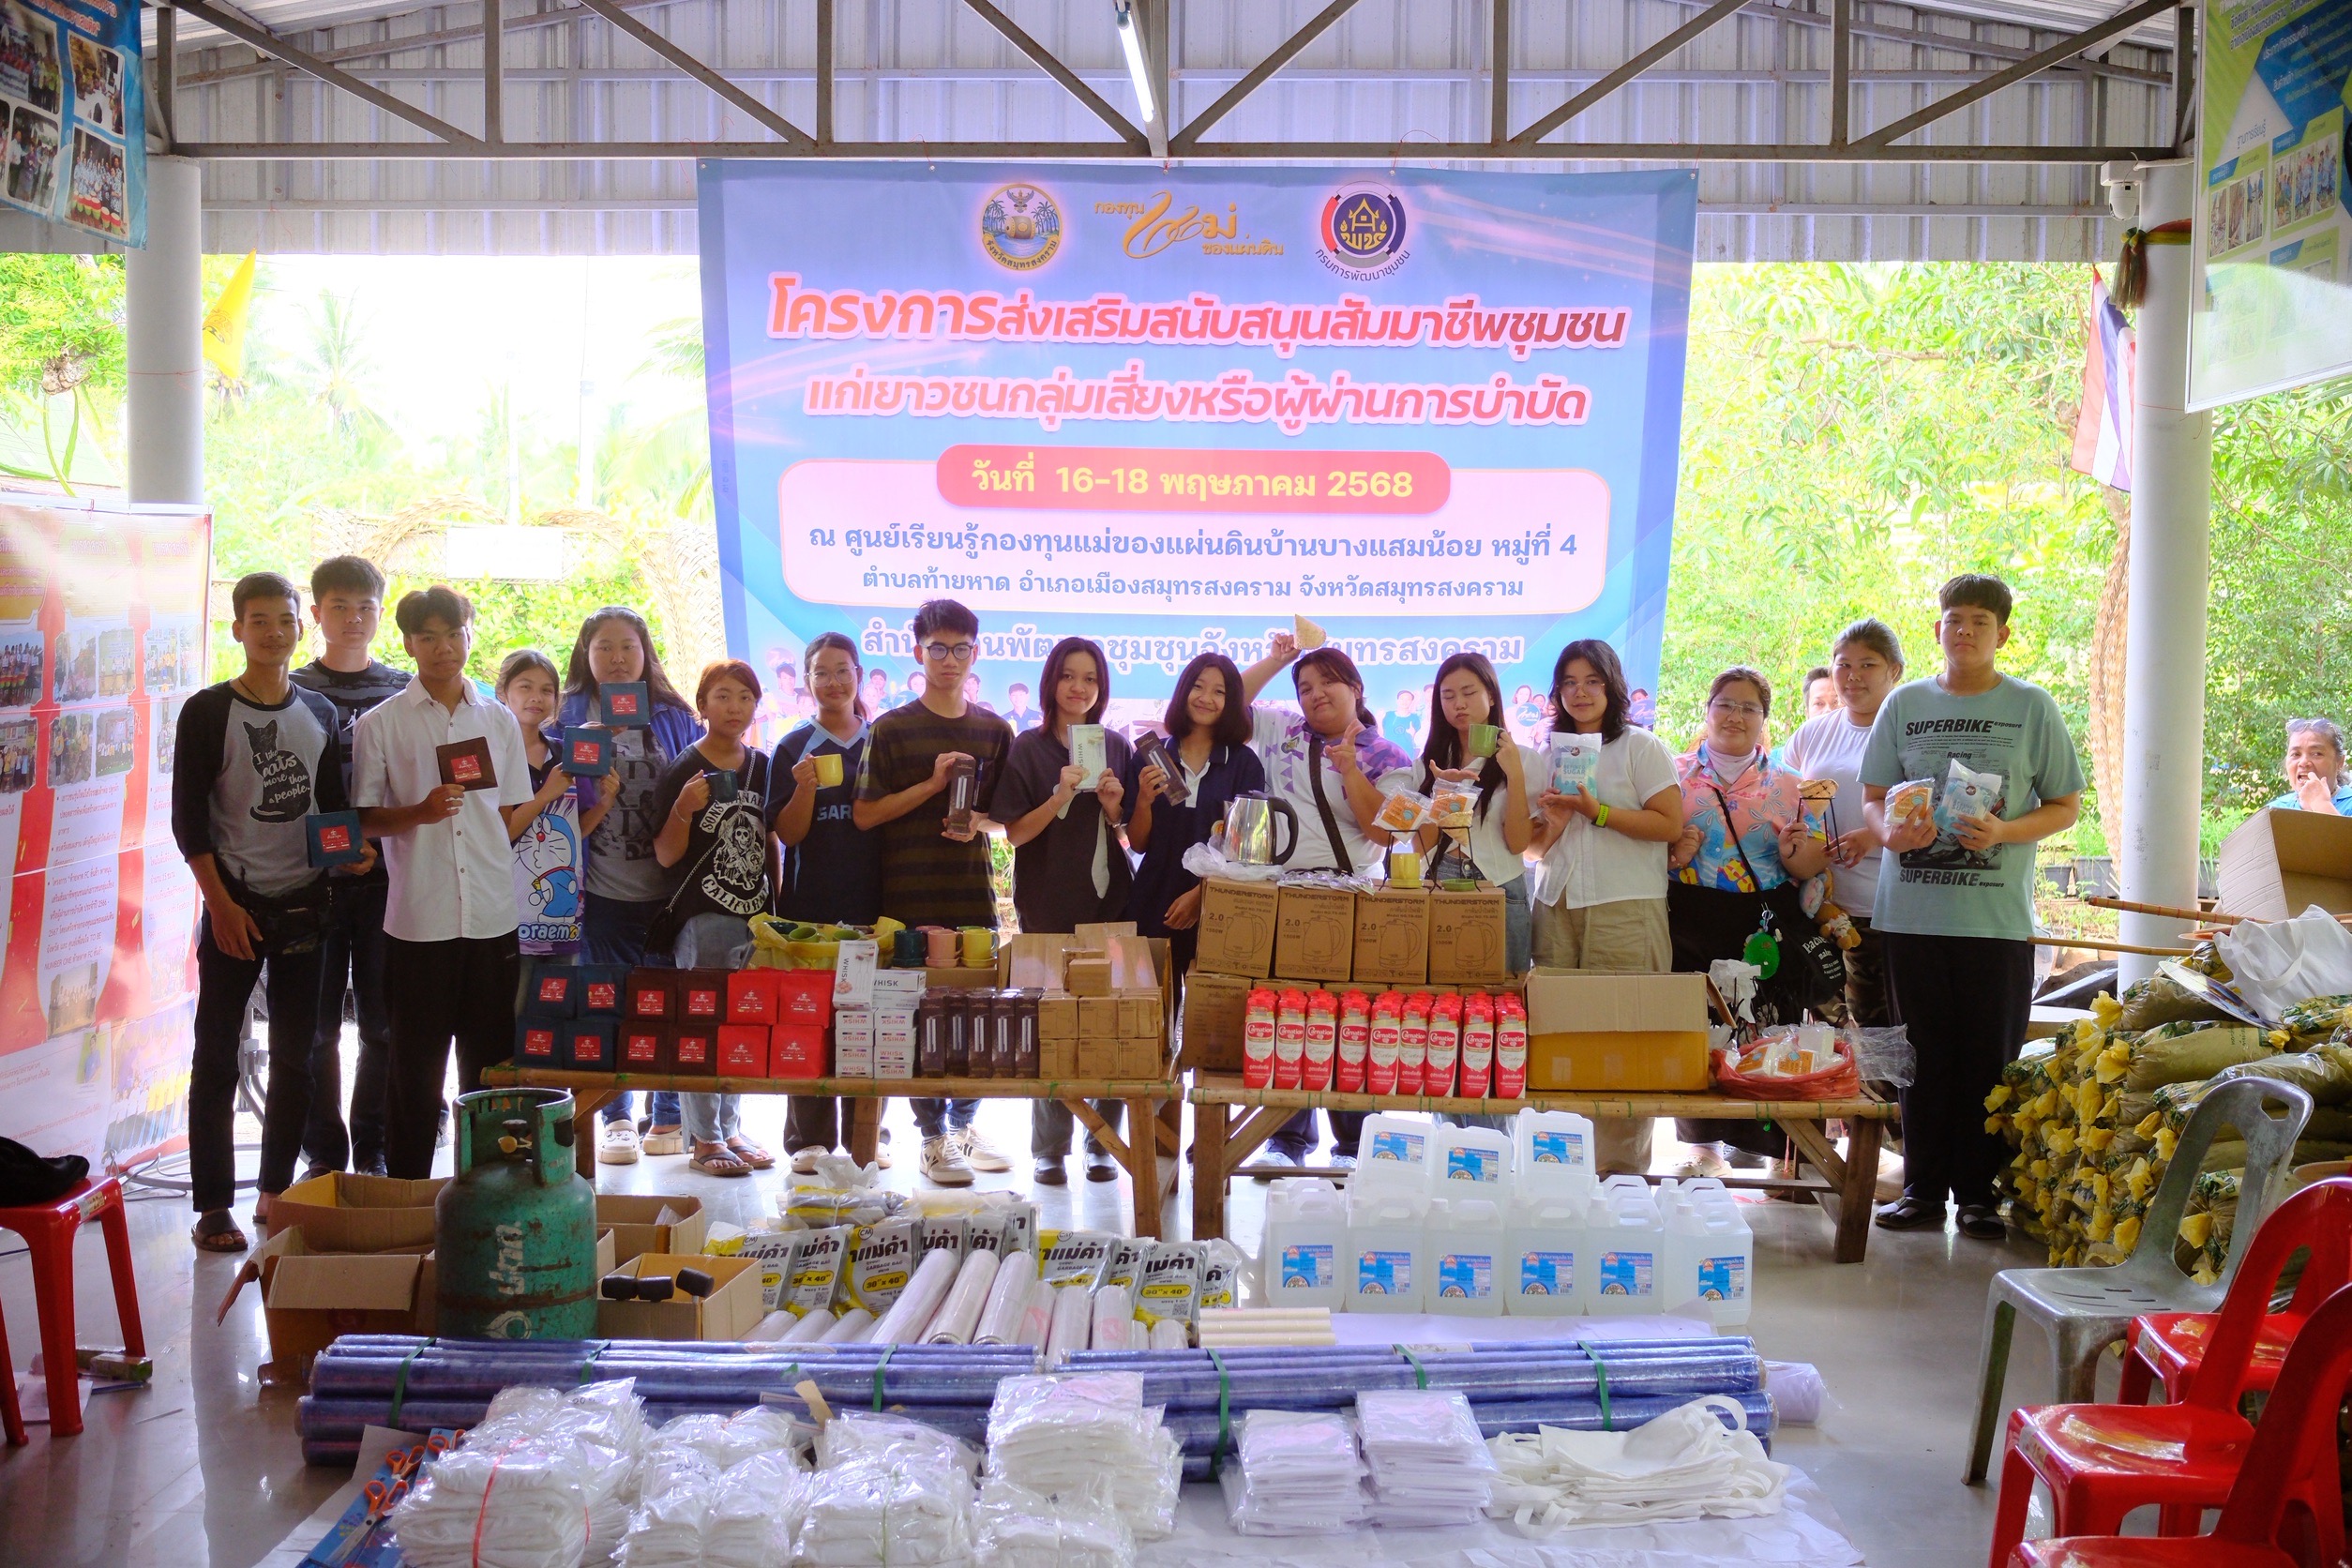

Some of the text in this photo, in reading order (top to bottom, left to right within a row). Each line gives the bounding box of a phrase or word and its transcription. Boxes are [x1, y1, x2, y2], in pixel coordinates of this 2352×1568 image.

[1094, 202, 1144, 220] กองทุน
[1201, 234, 1285, 256] ของแผ่นดิน
[986, 238, 1058, 270] จังหวัดสมุทรสงคราม
[1315, 248, 1411, 281] กรมการพัฒนาชุมชน
[769, 276, 1628, 356] โครงการส่งเสริมสนับสนุนสัมมาชีพชุมชน
[807, 364, 1587, 430] แก่เยาวชนกลุ่มเสี่ยงหรือผู้ผ่านการบำบัด
[972, 452, 1413, 503] วันที่ 16-18 พฤษภาคม 2568
[809, 522, 1577, 566] ณ ศูนย์เรียนรู้กองทุนแม่ของแผ่นดินบ้านบางแสมน้อย หมู่ที่ 4
[863, 567, 1524, 604] ตำบลท้ายหาด อำเภอเมืองสมุทรสงคราม จังหวัดสมุทรสงคราม
[1905, 719, 1995, 737] SUPERBIKE
[253, 749, 279, 765] I like
[1947, 751, 1972, 760] Racing
[263, 755, 297, 778] cats
[263, 774, 309, 788] more than
[701, 800, 725, 831] SONS
[1899, 869, 1981, 887] SUPERBIKE
[1210, 886, 1274, 899] THUNDERSTORM
[1284, 893, 1349, 901] THUNDERSTORM
[1360, 897, 1425, 905] THUNDERSTORM
[1209, 912, 1224, 921] 2.0
[1437, 925, 1452, 933] 2.0
[841, 957, 850, 983] WHISK
[1195, 983, 1243, 991] THUNDERSTORM
[1247, 1024, 1274, 1034] Carnation
[1278, 1026, 1304, 1036] Carnation
[1307, 1026, 1333, 1036] Carnation
[1342, 1027, 1366, 1037] Carnation
[1372, 1029, 1399, 1041] Carnation
[1401, 1030, 1426, 1041] Carnation
[1430, 1033, 1455, 1043] Carnation
[1466, 1034, 1491, 1045] Carnation
[1500, 1033, 1525, 1045] Carnation
[859, 1228, 872, 1237] CM
